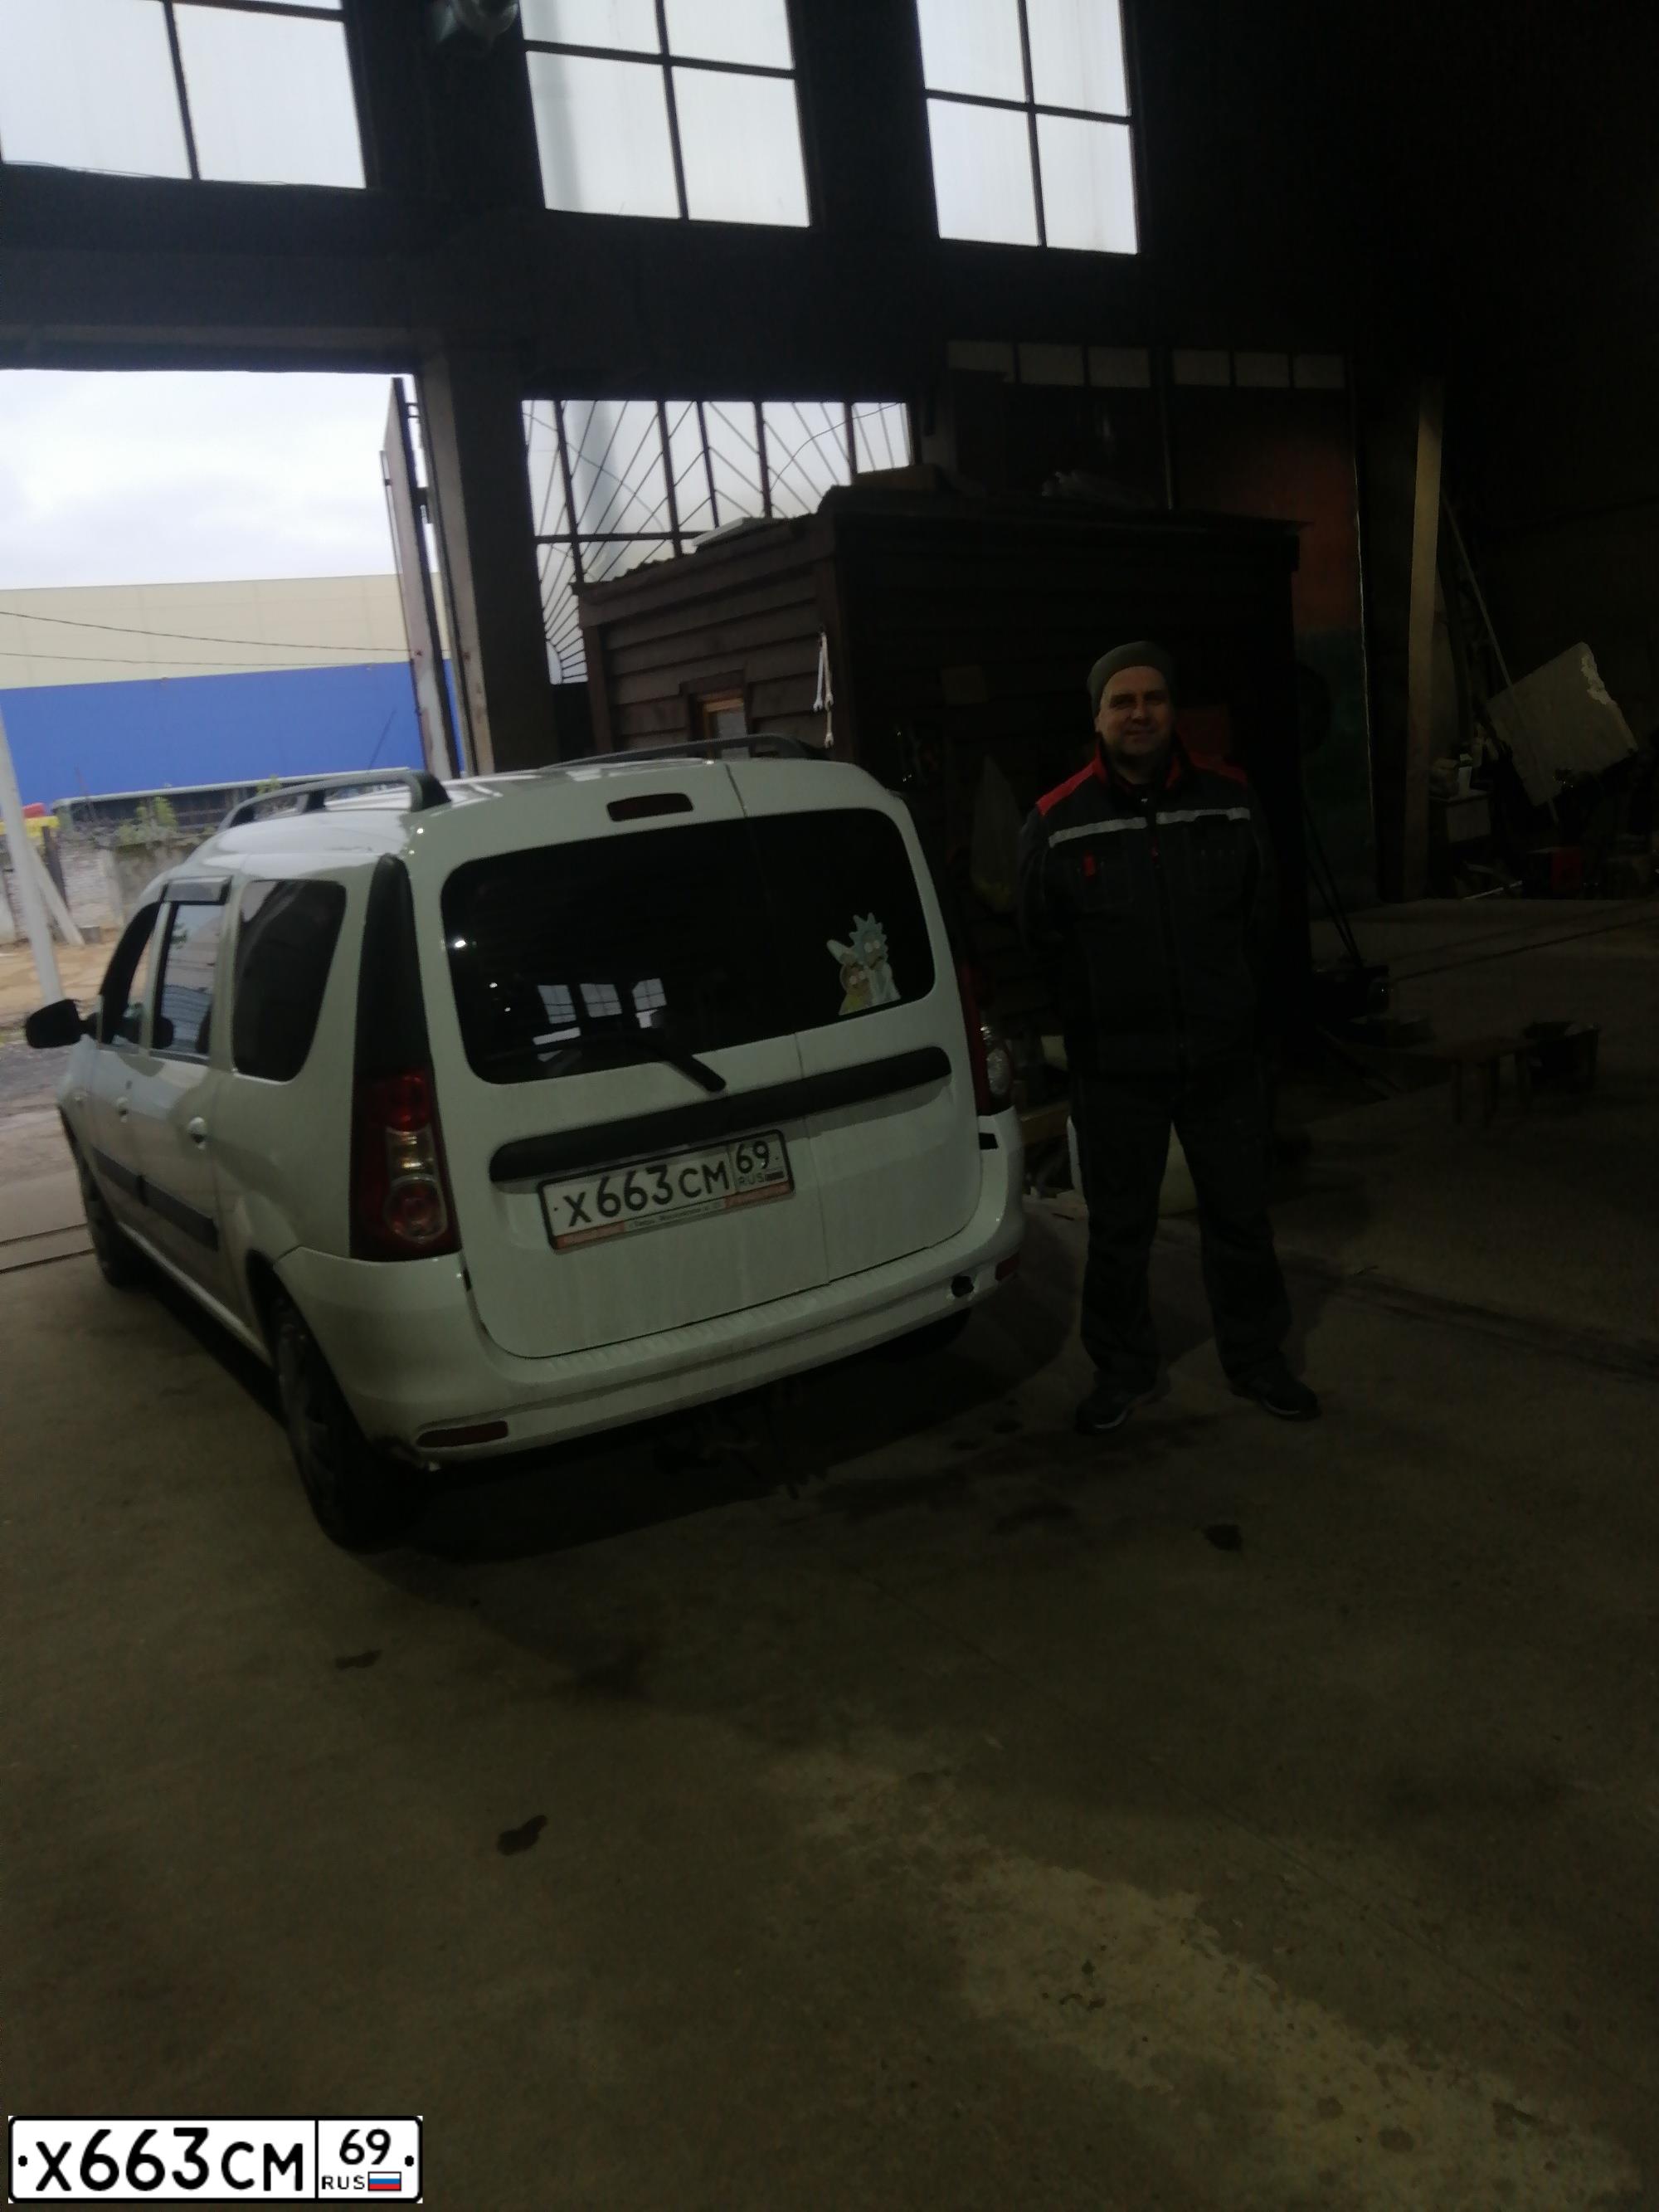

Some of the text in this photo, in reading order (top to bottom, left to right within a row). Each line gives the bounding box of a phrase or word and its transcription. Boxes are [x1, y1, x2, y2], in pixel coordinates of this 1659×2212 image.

[564, 1161, 730, 1226] Х663СМ
[737, 1141, 770, 1174] 69
[737, 1172, 764, 1186] RUS
